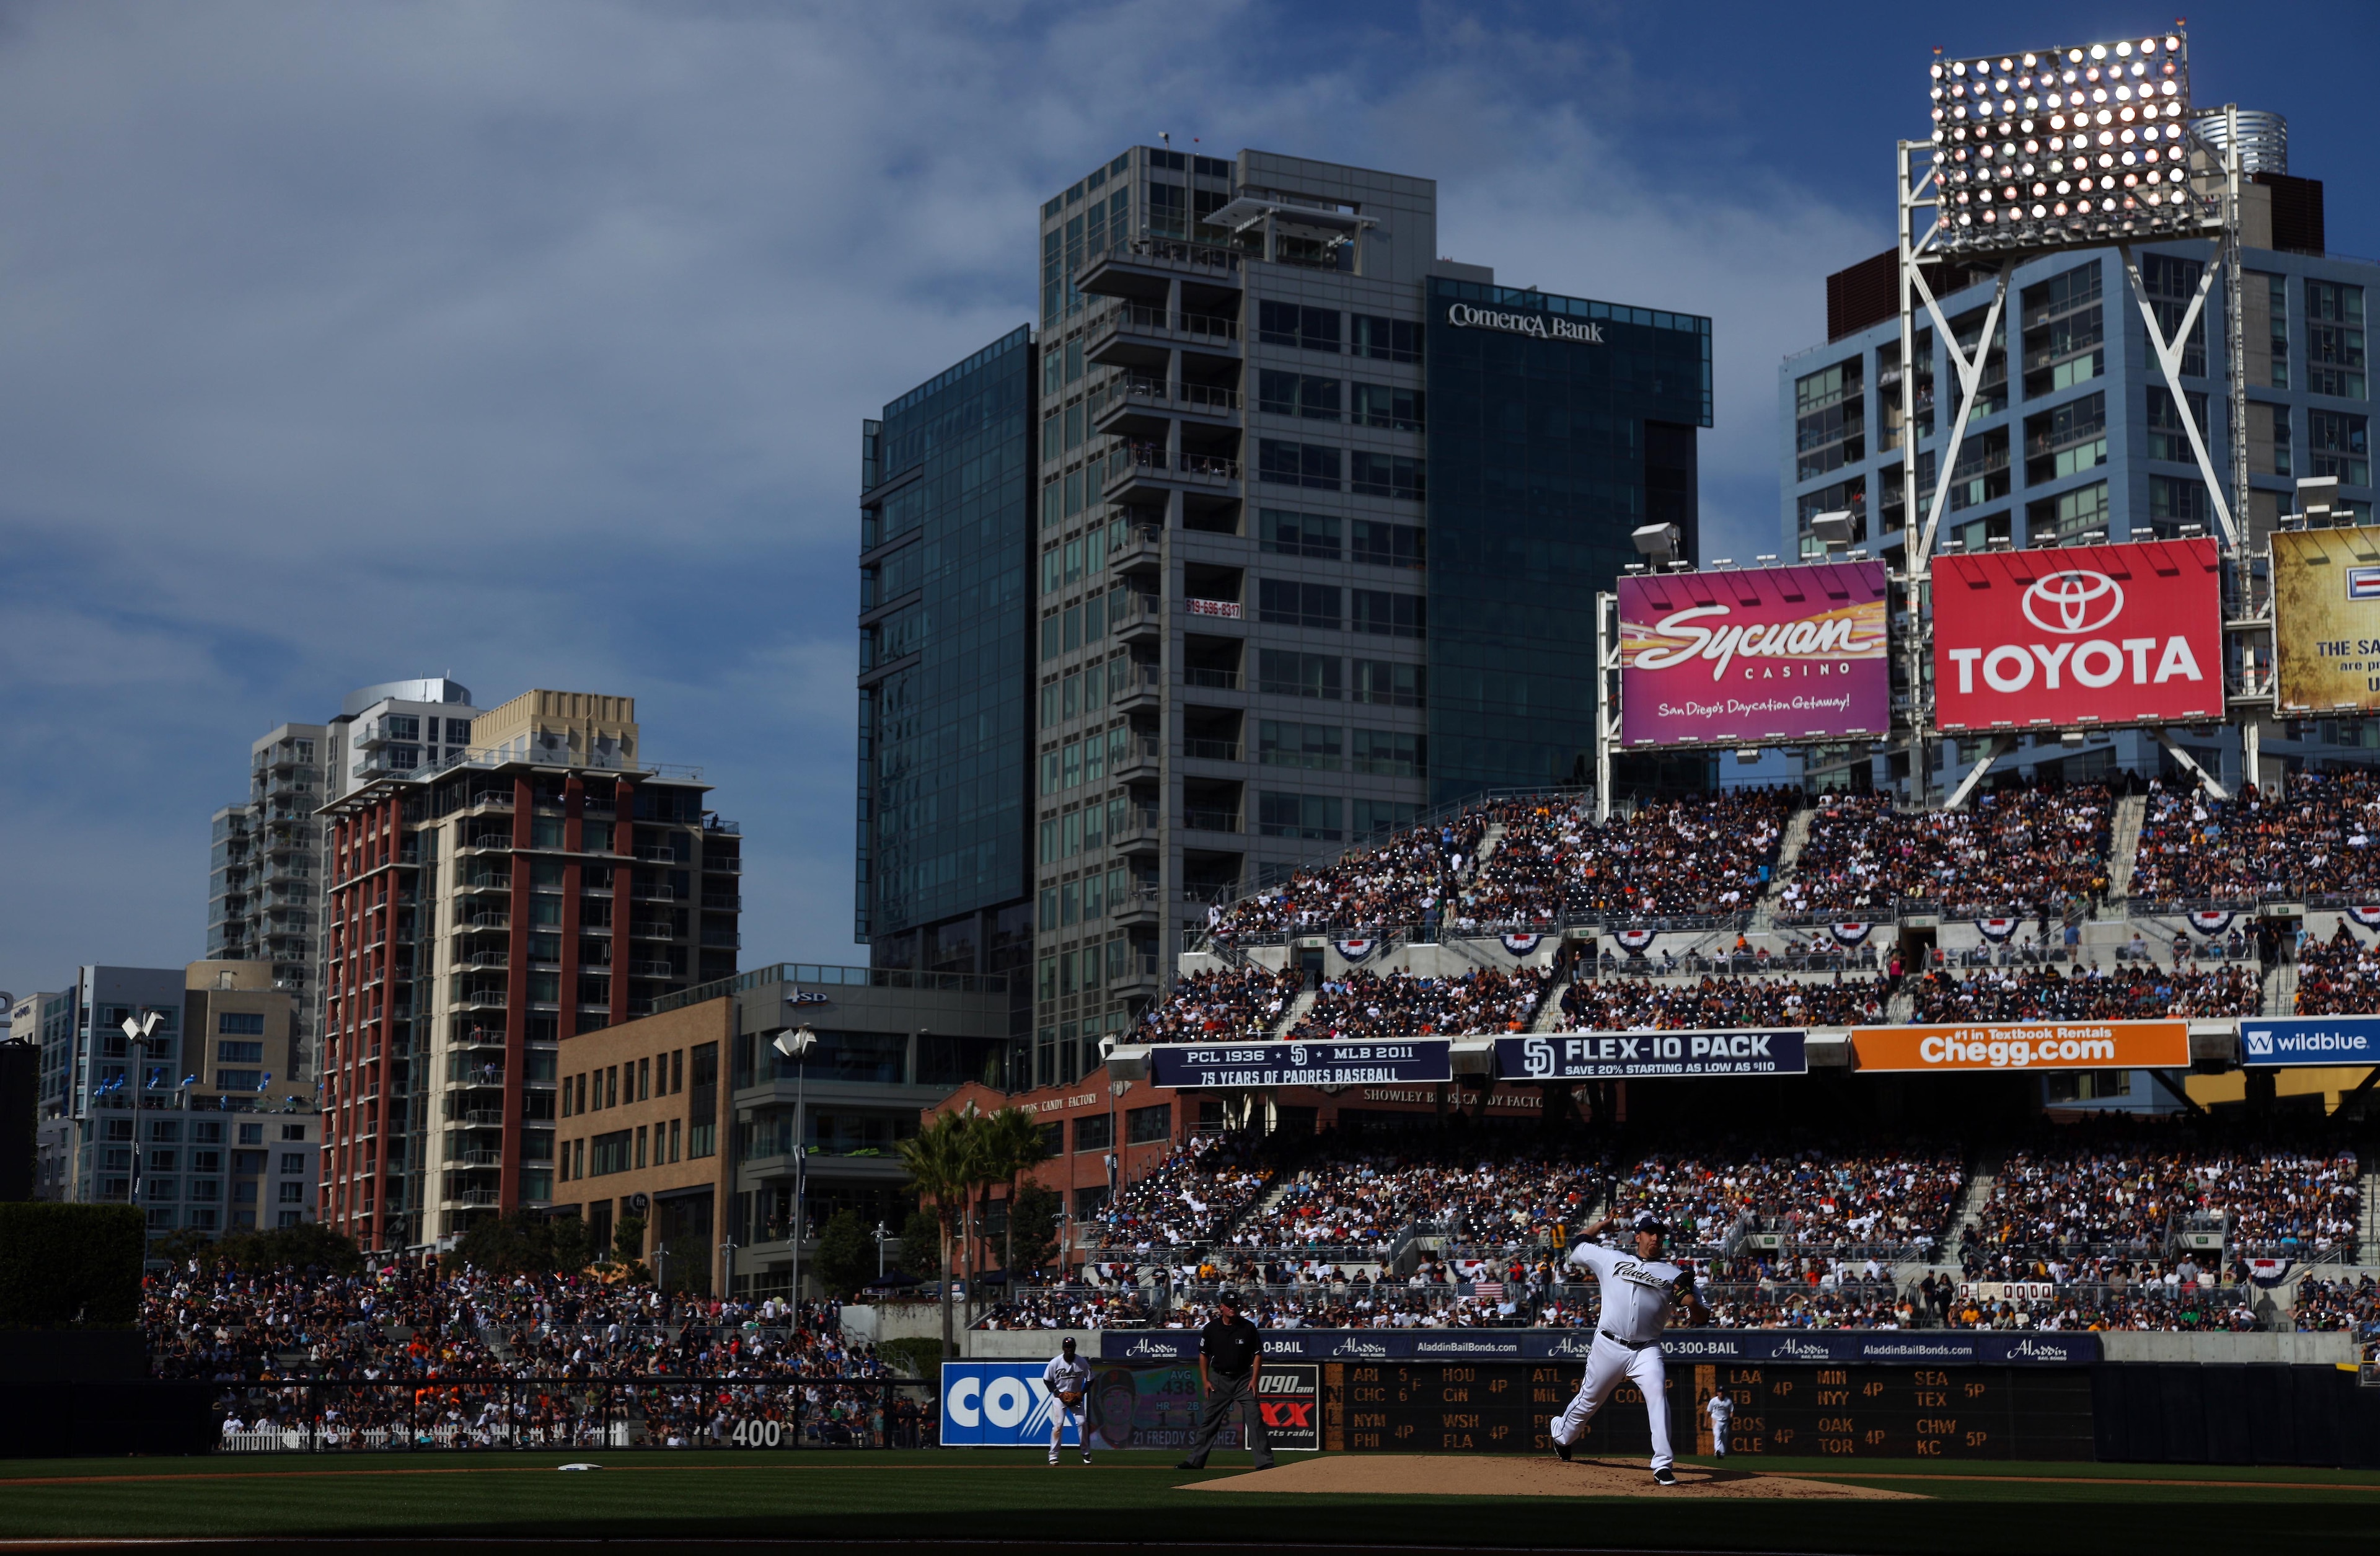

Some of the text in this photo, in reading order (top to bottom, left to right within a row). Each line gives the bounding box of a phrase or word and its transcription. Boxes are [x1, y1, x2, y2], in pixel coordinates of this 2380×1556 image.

[1551, 317, 1605, 343] Bank
[1635, 604, 1872, 681] Sycuan
[2316, 640, 2350, 656] THE
[1744, 663, 1849, 679] CASINO
[1949, 635, 2203, 694] TOYOTA
[2340, 661, 2362, 671] are
[1658, 692, 1850, 718] San Diego's Daycation Getaway!
[785, 986, 827, 1002] 4SD
[1955, 1027, 2112, 1040] #1 in Textbook Rentals
[1691, 1035, 1772, 1058] PACK
[2276, 1032, 2368, 1051] wildblue
[1187, 1050, 1265, 1063] PCL 1936
[1333, 1046, 1413, 1059] MLB 2011
[1919, 1036, 2115, 1067] Chegg.com
[1565, 1065, 1594, 1075] SAVE
[1598, 1064, 1623, 1075] 20%
[1626, 1063, 1682, 1074] STARTING
[1686, 1063, 1702, 1073] AS
[1704, 1063, 1732, 1072] LOW
[1735, 1062, 1751, 1072] AS
[1201, 1068, 1398, 1085] 75 YEARS OF PADRES BASEBALL
[1042, 1098, 1064, 1112] CANDY
[1068, 1093, 1097, 1108] FACTORY
[1364, 1089, 1423, 1103] SHOWLEY
[1463, 1093, 1503, 1106] CADY
[1507, 1095, 1543, 1108] FACTO
[1612, 1261, 1668, 1289] Padres
[1126, 1338, 1177, 1357] Aladdin
[1263, 1342, 1303, 1353] 0-BAIL
[1333, 1337, 1386, 1356] Aladdin
[1417, 1342, 1517, 1353] AladdinBailBonds.com
[1548, 1337, 1592, 1358] Aladd
[1659, 1342, 1739, 1355] 0-300-BAIL
[1771, 1338, 1829, 1358] Aladdin
[1864, 1345, 1972, 1355] AladdinBailBonds.com
[2007, 1339, 2067, 1359] Aladdin
[1170, 1370, 1191, 1379] AVG
[1352, 1368, 1408, 1382] ARI 5
[1442, 1368, 1475, 1382] HOU
[1532, 1368, 1562, 1382] ATL
[1729, 1369, 1763, 1384] LAA
[1817, 1370, 1848, 1385] MIN
[1914, 1371, 1949, 1386] SEA
[1157, 1381, 1196, 1395] .438
[1412, 1378, 1422, 1391] F
[1488, 1379, 1508, 1394] 4P
[1570, 1379, 1583, 1393] 5
[1772, 1381, 1793, 1396] 4P
[1862, 1382, 1884, 1397] 4P
[1964, 1383, 1986, 1398] 5P
[1353, 1388, 1386, 1402] CHC
[1443, 1388, 1468, 1402] CIN
[1533, 1389, 1561, 1402] MIL
[1730, 1390, 1752, 1405] TB
[1817, 1390, 1850, 1406] NYY
[1915, 1391, 1947, 1407] TEX
[1155, 1402, 1170, 1410] HR
[1186, 1402, 1200, 1410] 2B
[1158, 1412, 1168, 1426] 1
[1188, 1412, 1197, 1426] 1
[1354, 1413, 1386, 1428] NYM
[1442, 1414, 1479, 1428] WSH
[1534, 1415, 1553, 1428] PI
[1731, 1417, 1765, 1432] BOS
[1818, 1418, 1854, 1433] OAK
[1916, 1419, 1957, 1434] CHW
[732, 1419, 780, 1447] 400
[1133, 1431, 1237, 1445] 21 FREDDY SHEZ
[1395, 1425, 1414, 1439] 4P
[1489, 1425, 1509, 1439] 4P
[1580, 1425, 1592, 1439] P
[1774, 1429, 1794, 1444] 4P
[1864, 1430, 1885, 1445] 4P
[1965, 1431, 1988, 1447] 5P
[1354, 1434, 1380, 1448] PHI
[1443, 1434, 1473, 1449] FLA
[1535, 1434, 1553, 1448] ST
[1732, 1437, 1763, 1452] CLE
[1818, 1438, 1854, 1454] TOR
[1916, 1439, 1941, 1455] KC
